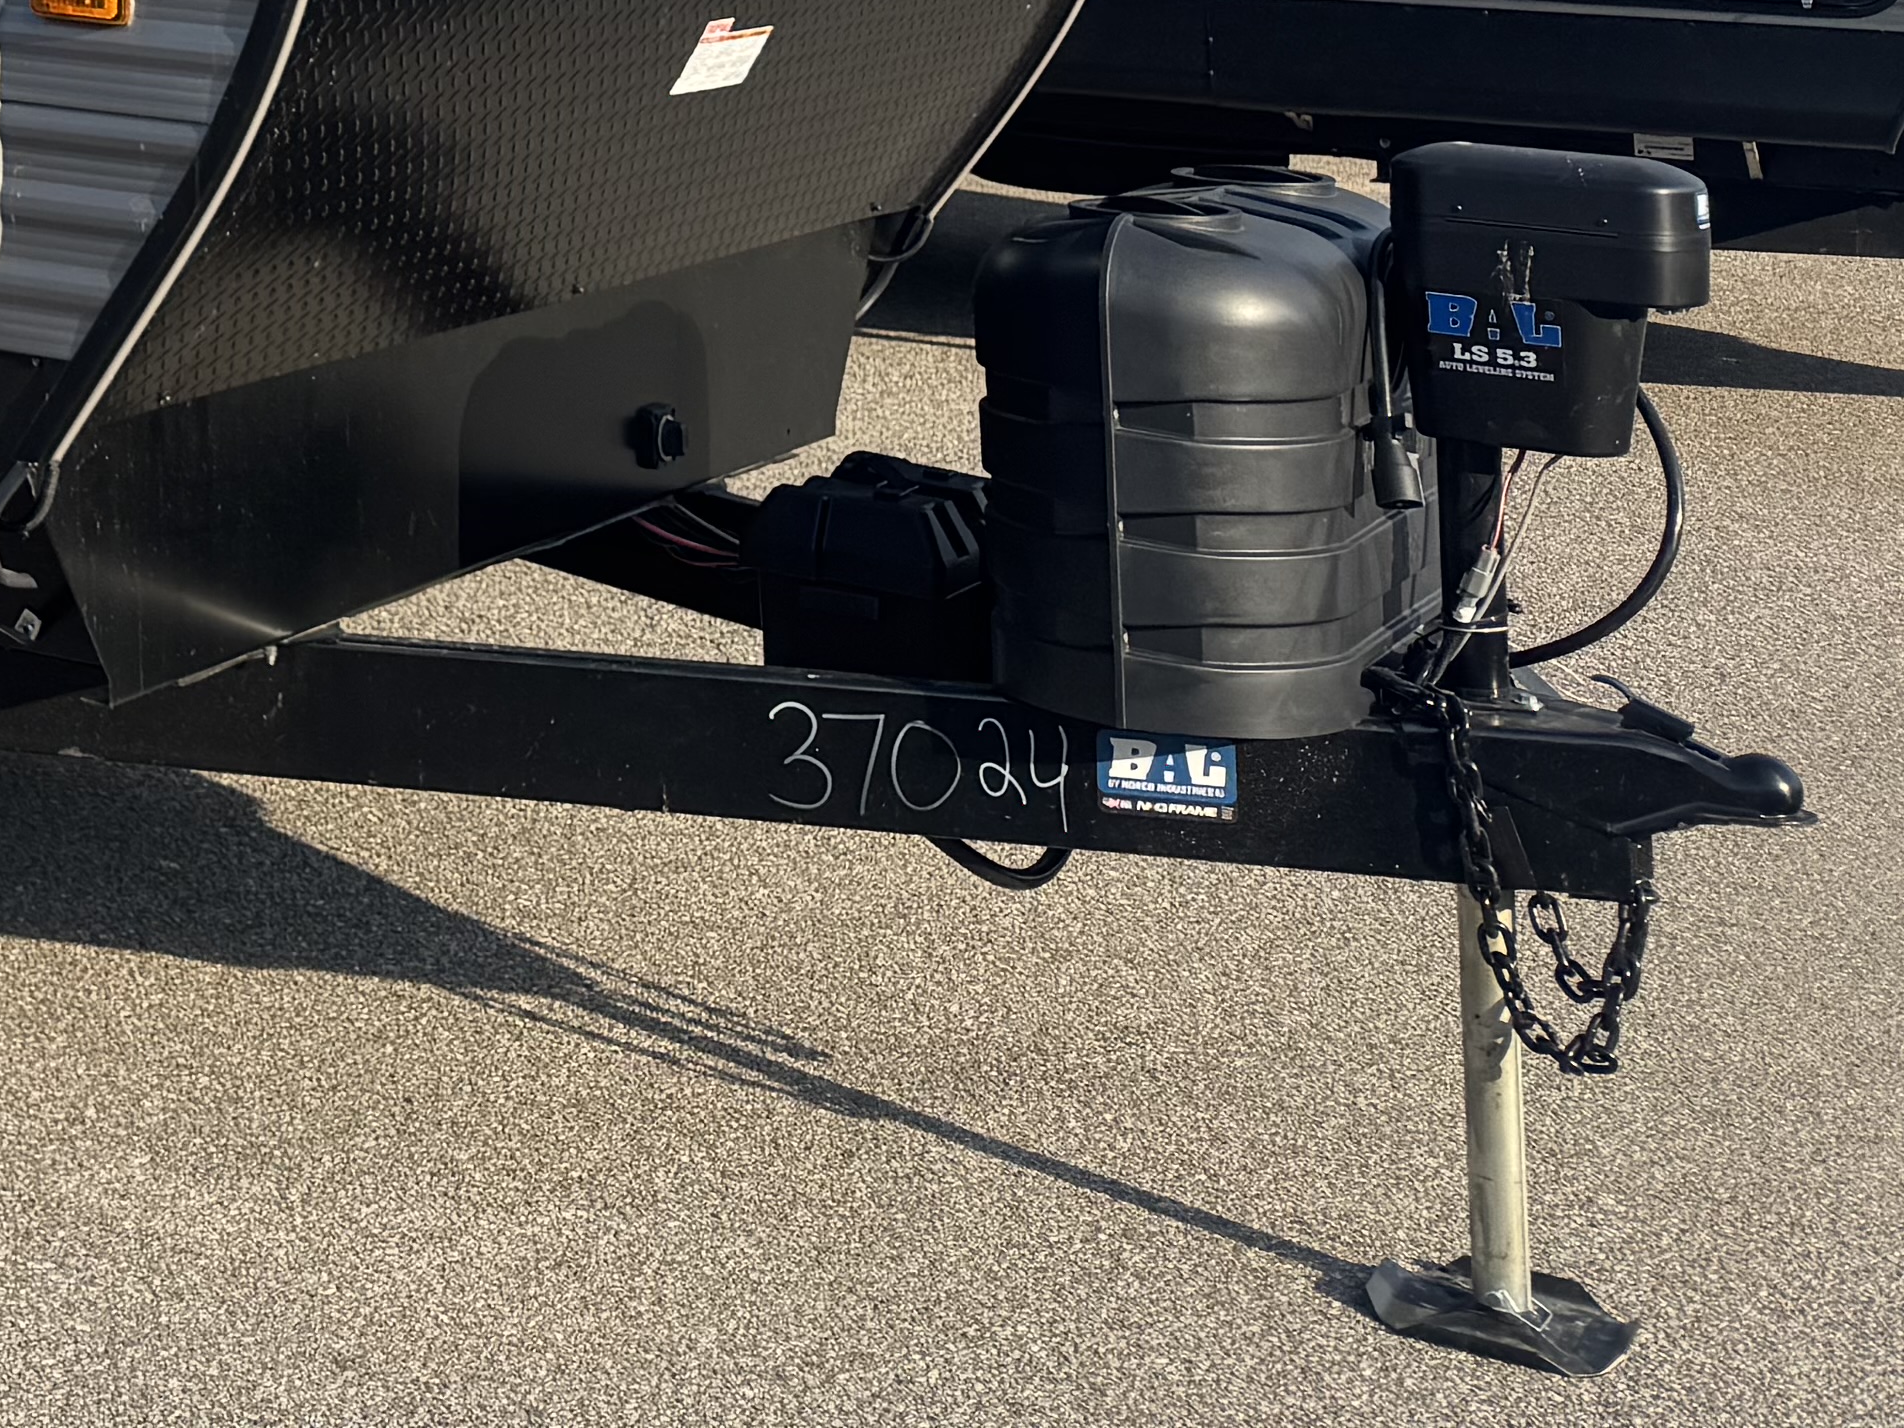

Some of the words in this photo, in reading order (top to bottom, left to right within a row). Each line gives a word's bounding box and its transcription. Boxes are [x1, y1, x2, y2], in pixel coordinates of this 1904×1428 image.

[1425, 291, 1562, 348] BAL
[1439, 360, 1464, 372] AUTO
[1466, 363, 1513, 378] LEVELING
[1515, 370, 1555, 382] SYSTEM
[1452, 342, 1490, 363] LS
[1495, 347, 1538, 369] 5.3
[768, 700, 1069, 833] 37024
[1109, 736, 1227, 787] BAL
[1121, 779, 1155, 793] NORCO
